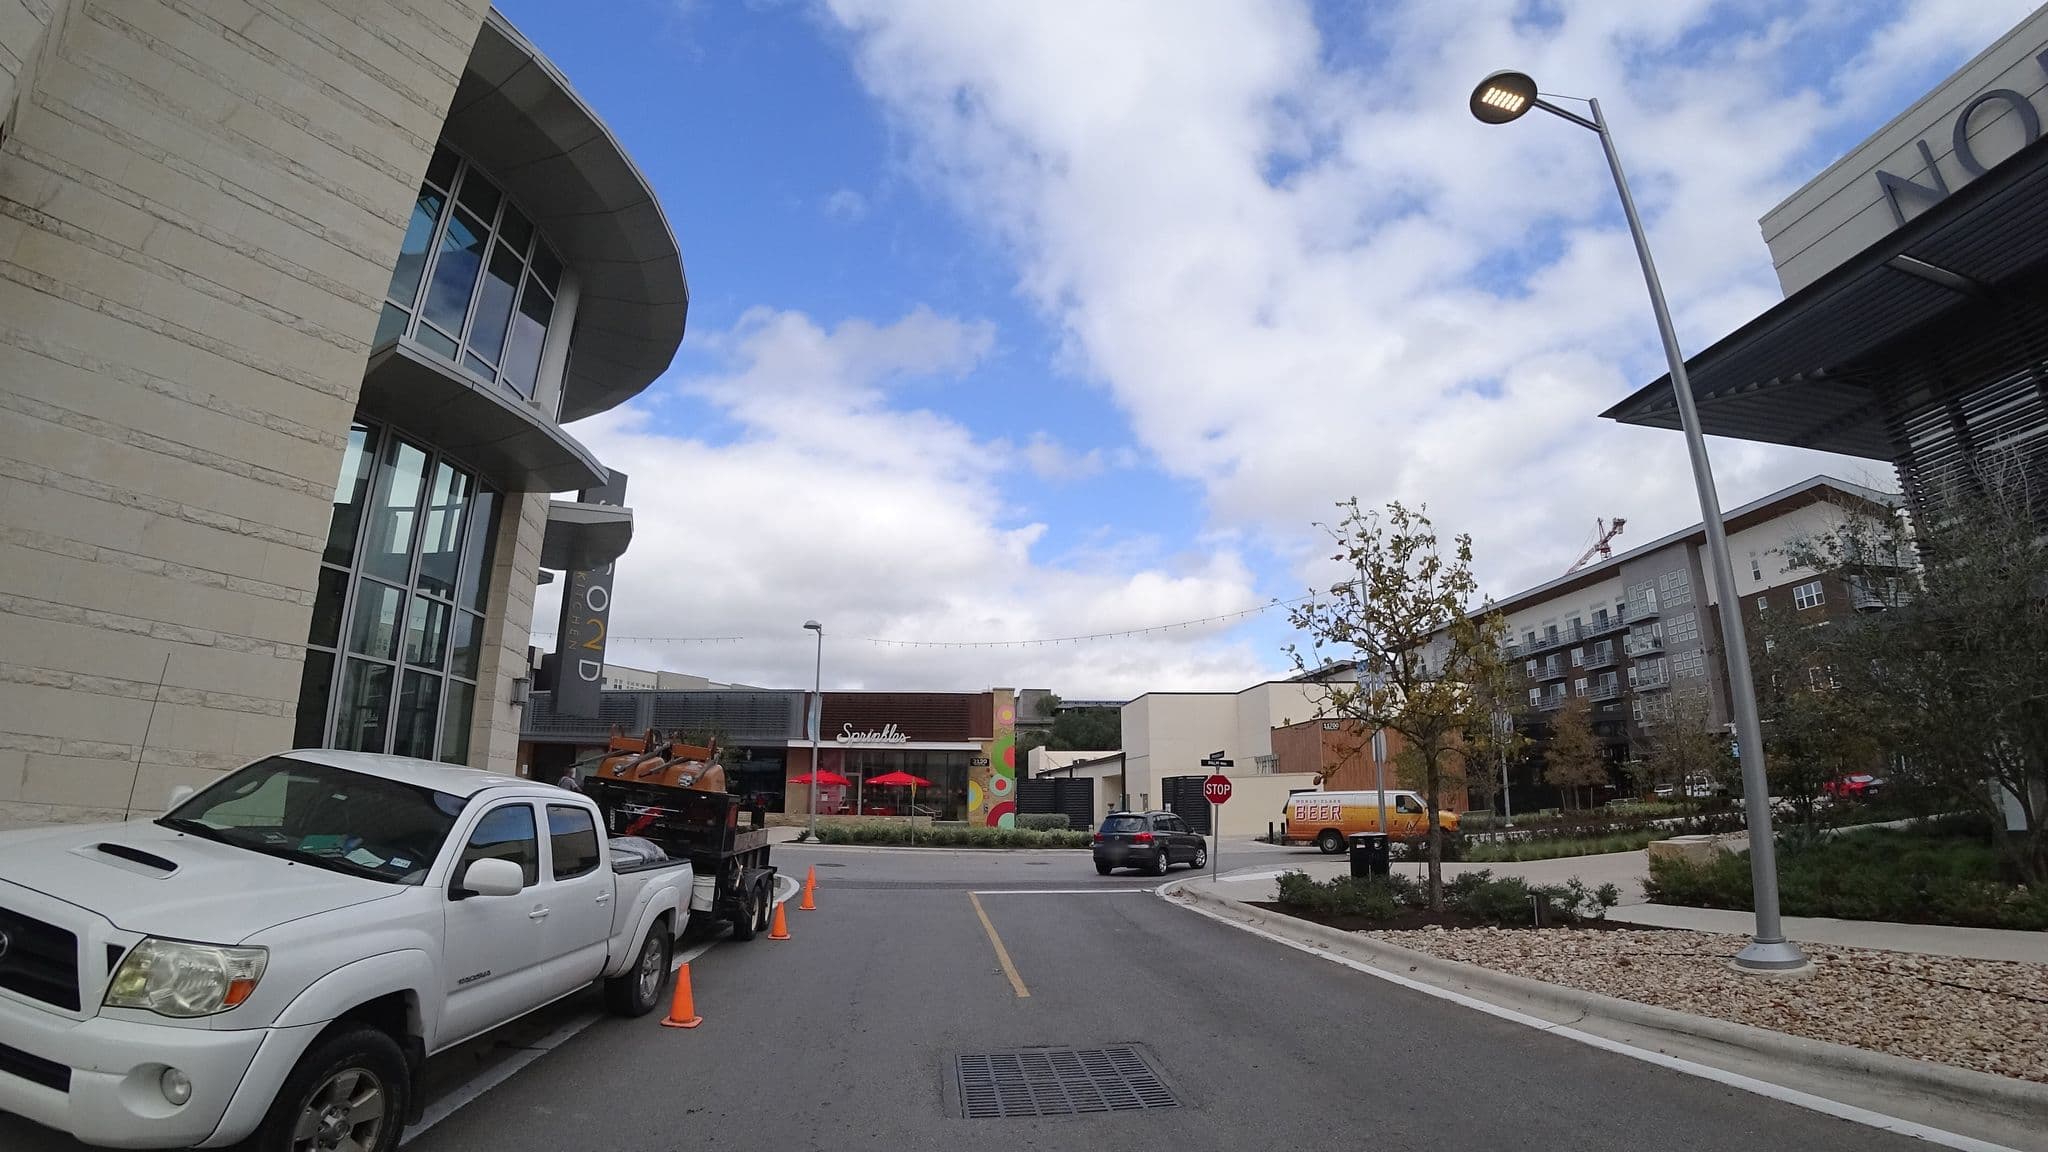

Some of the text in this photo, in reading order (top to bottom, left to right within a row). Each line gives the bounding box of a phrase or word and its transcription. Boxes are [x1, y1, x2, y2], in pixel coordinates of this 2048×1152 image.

[1874, 47, 2048, 227] NO
[568, 570, 588, 650] KITCHEN
[836, 722, 911, 746] Sprinkles
[1205, 783, 1231, 795] STOP
[1294, 804, 1343, 822] BEER
